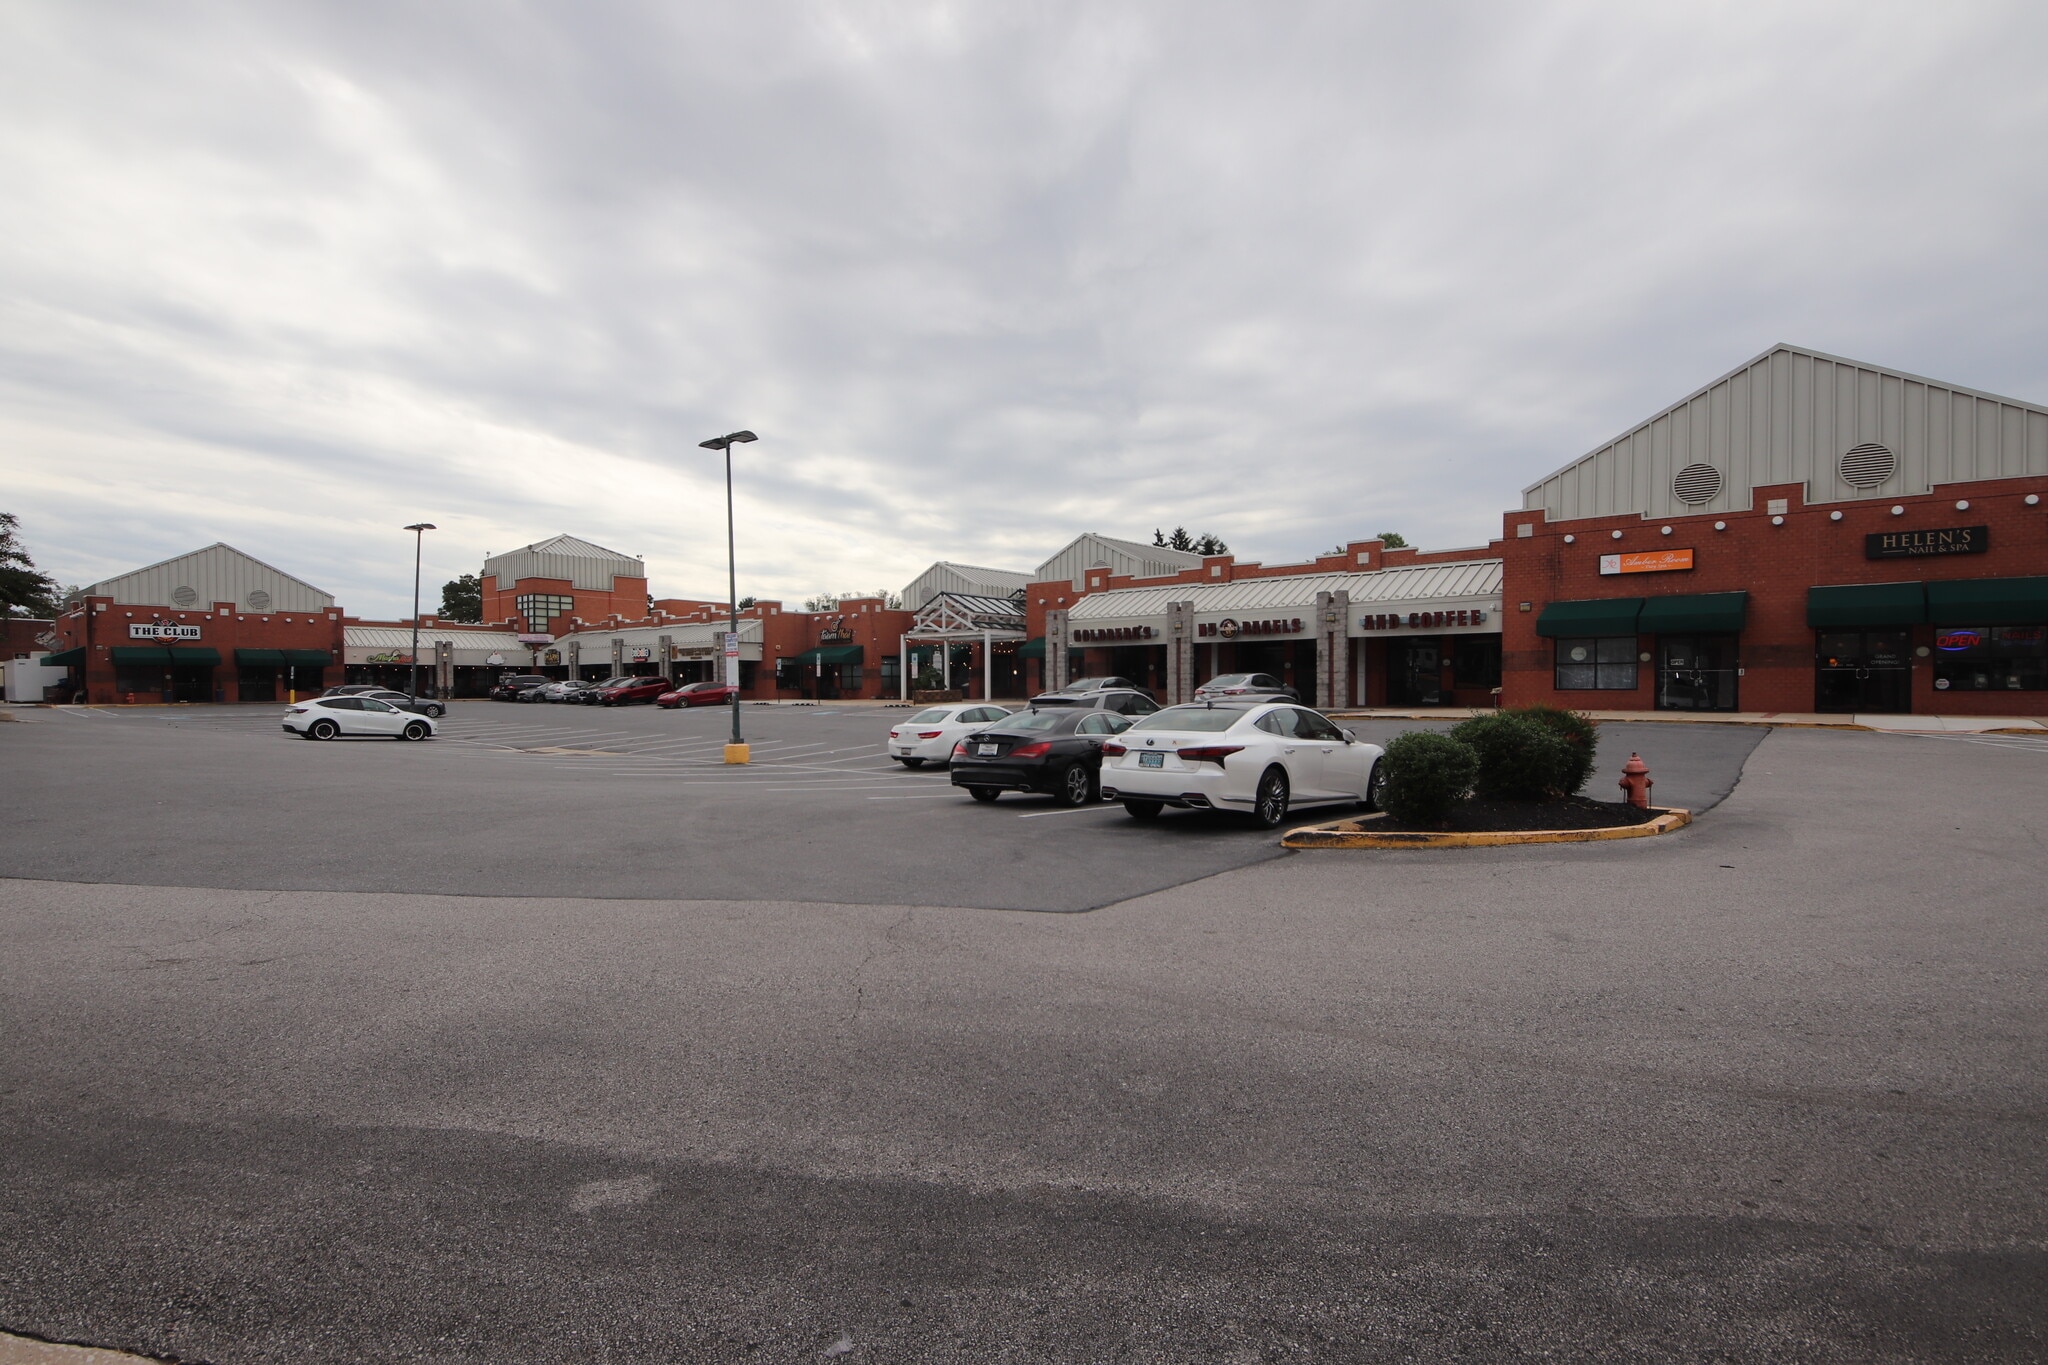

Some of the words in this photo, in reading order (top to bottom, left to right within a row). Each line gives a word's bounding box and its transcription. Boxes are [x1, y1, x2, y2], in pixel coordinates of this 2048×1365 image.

[1883, 529, 1971, 548] HELEN'S
[1623, 556, 1657, 566] Amber
[1660, 553, 1689, 564] Room
[1198, 623, 1217, 637] NY
[1242, 618, 1302, 635] BAGELS
[1364, 614, 1400, 630] AND
[1409, 610, 1480, 629] COFFEE
[133, 627, 160, 636] THE
[163, 627, 198, 637] CLUB
[1073, 625, 1151, 642] GOLDBERG'S
[2003, 631, 2043, 639] NAILS
[1936, 635, 1982, 647] OPEN
